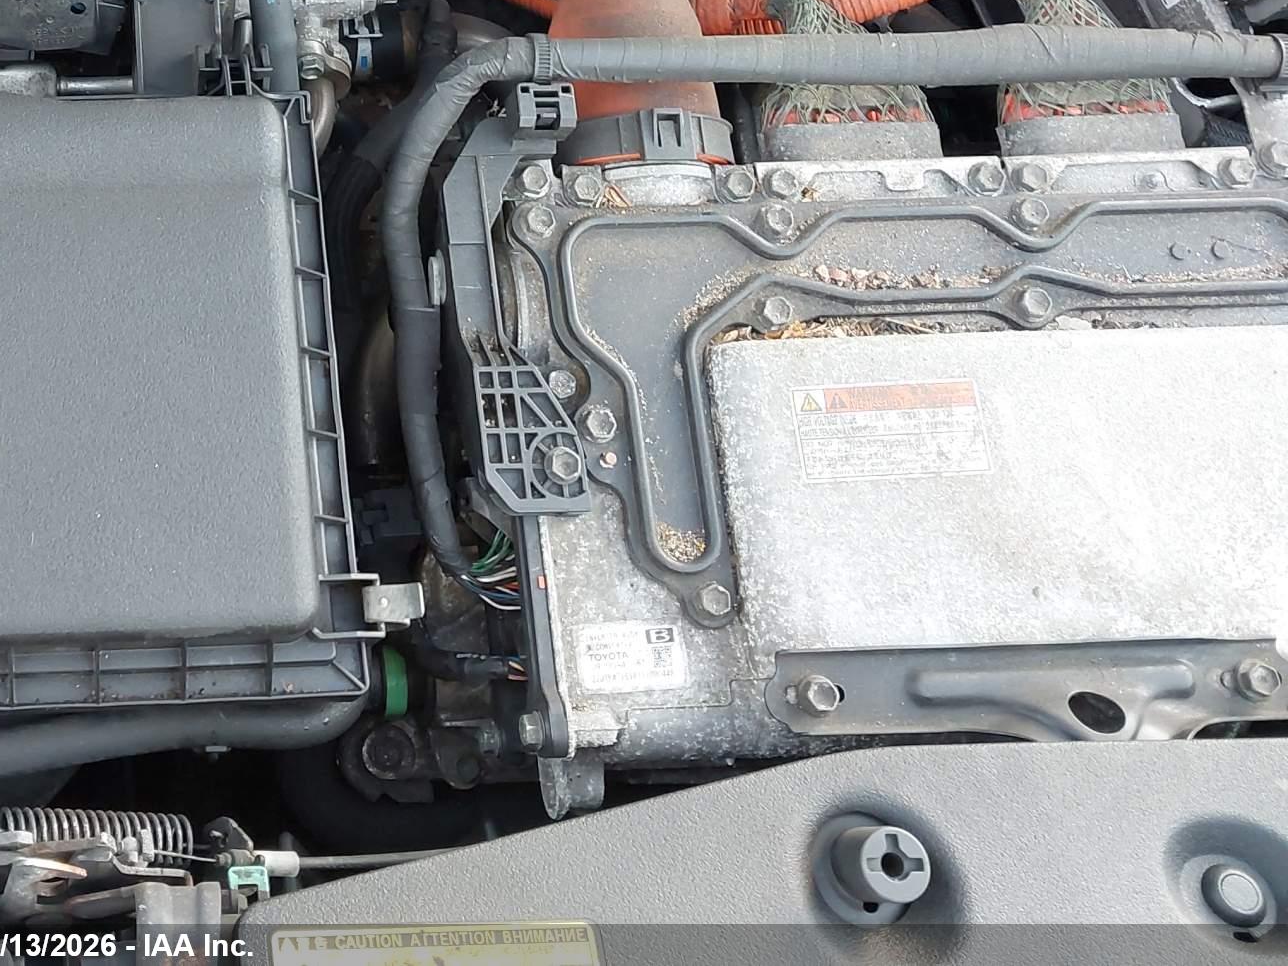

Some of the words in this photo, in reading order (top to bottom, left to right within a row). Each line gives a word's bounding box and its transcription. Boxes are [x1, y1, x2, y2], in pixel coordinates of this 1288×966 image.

[649, 628, 670, 643] B
[588, 651, 629, 662] TOYOTA
[334, 933, 403, 950] CAUTION
[410, 930, 496, 948] ATTENTION
[502, 927, 587, 945] ВНИМАНИЕ
